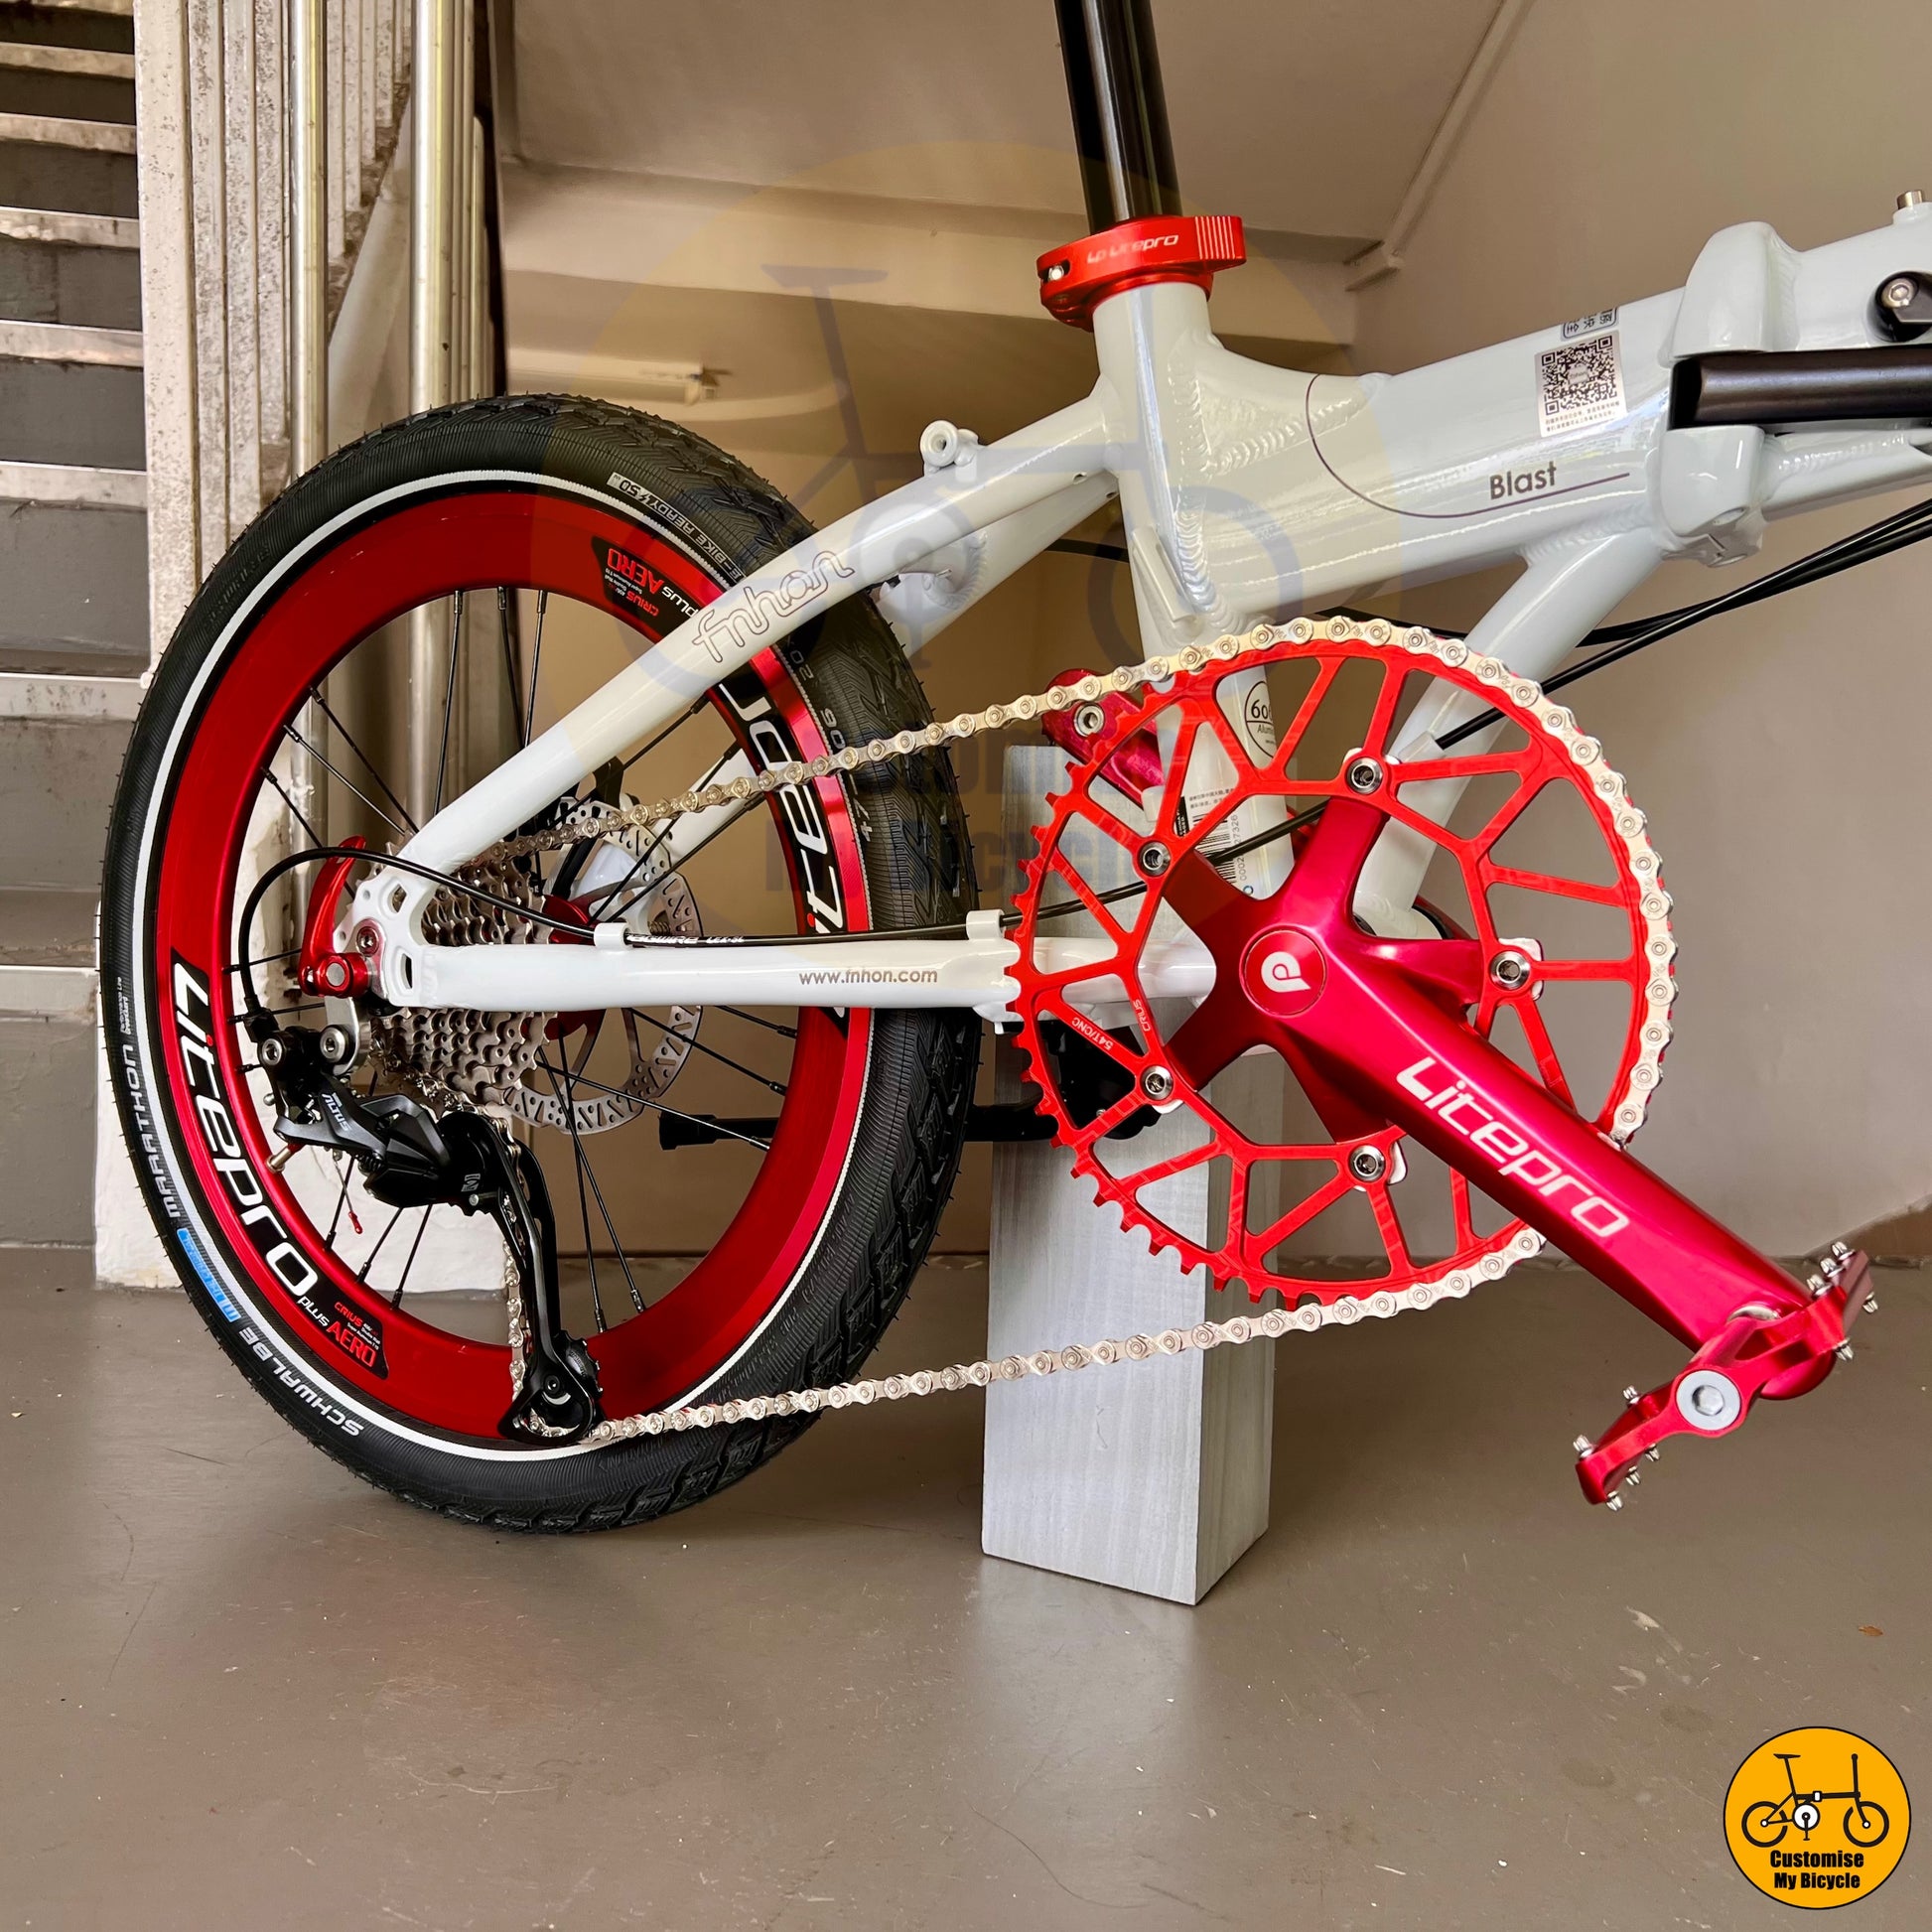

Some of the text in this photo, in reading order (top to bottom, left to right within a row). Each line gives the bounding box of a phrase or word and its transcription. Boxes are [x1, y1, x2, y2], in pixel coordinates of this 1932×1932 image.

[1490, 461, 1557, 499] Blast
[619, 480, 743, 579] E-BIKE READY 50
[608, 548, 663, 595] AERO
[626, 591, 660, 618] CRIUS
[692, 550, 855, 663] fnhon
[799, 968, 938, 986] www.fnhon.com
[1071, 1017, 1114, 1051] 54T/CNC
[1132, 999, 1152, 1033] CRIUS
[122, 1043, 184, 1219] MARATHON
[174, 961, 320, 1298] Litepro
[322, 1093, 350, 1133] ALTUS
[1396, 1056, 1631, 1239] Litepro
[298, 1296, 331, 1328] plus
[334, 1301, 364, 1329] CRIUS
[325, 1316, 376, 1368] AERO
[238, 1326, 365, 1437] SCHWALBE
